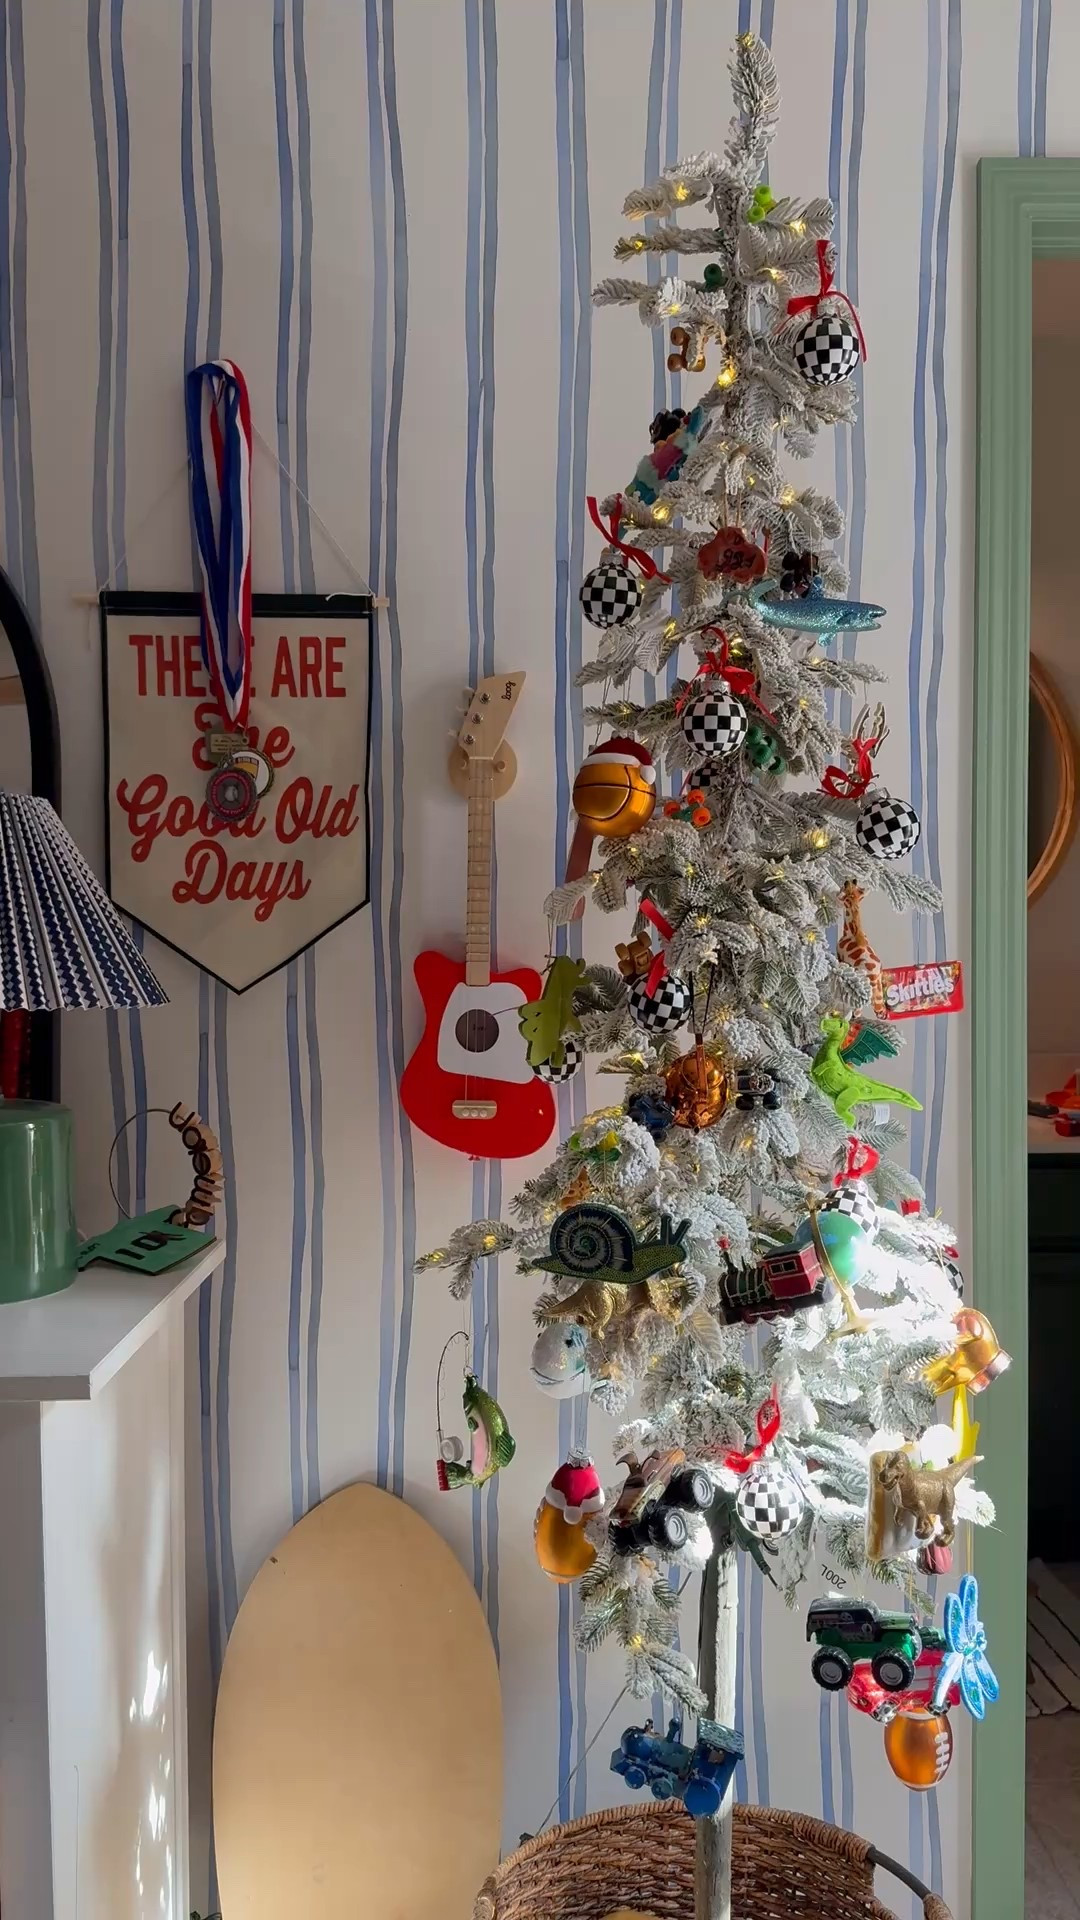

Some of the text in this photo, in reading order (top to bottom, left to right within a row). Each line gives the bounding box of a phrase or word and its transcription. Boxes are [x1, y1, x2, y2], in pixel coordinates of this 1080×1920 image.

[129, 634, 347, 698] THE ARE
[501, 681, 517, 701] loog
[275, 776, 360, 844] Old
[172, 839, 312, 921] Days
[886, 972, 955, 1006] Skittles
[820, 1563, 847, 1590] 200L
